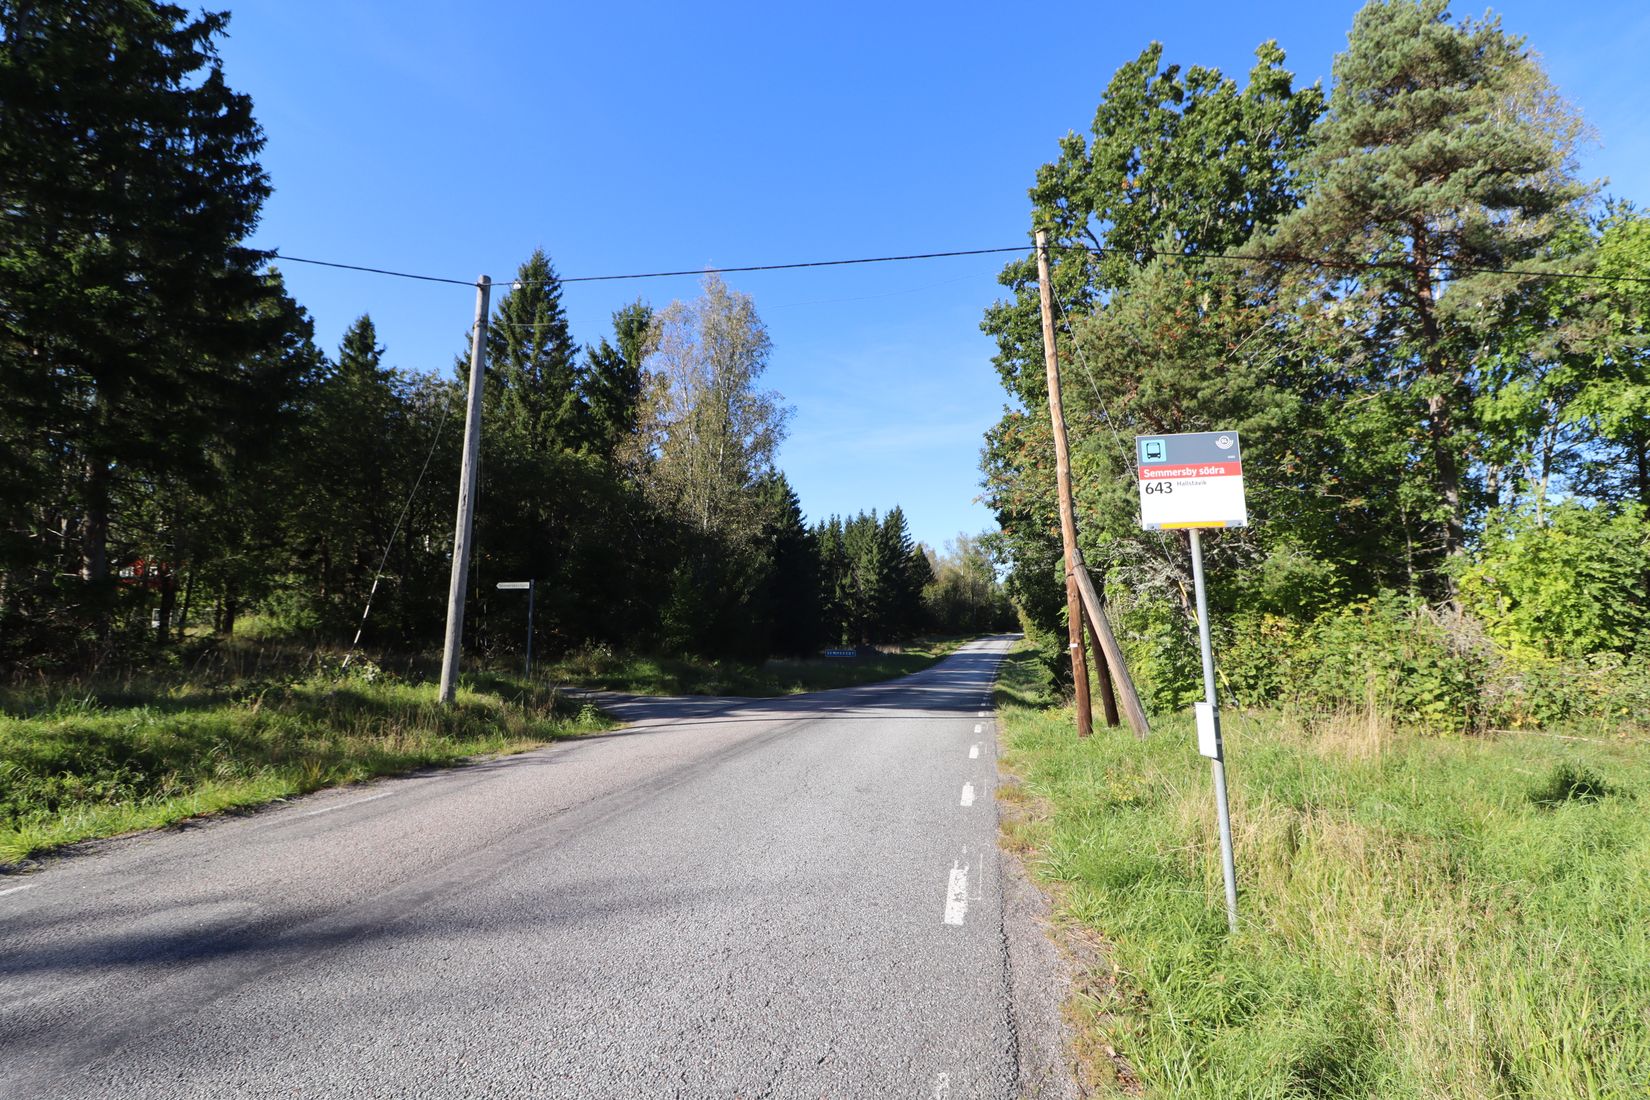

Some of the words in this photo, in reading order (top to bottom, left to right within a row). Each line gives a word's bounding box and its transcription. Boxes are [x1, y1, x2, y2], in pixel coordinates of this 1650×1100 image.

[1143, 467, 1197, 478] Semmersby
[1199, 466, 1225, 475] södra
[1145, 481, 1173, 495] 643
